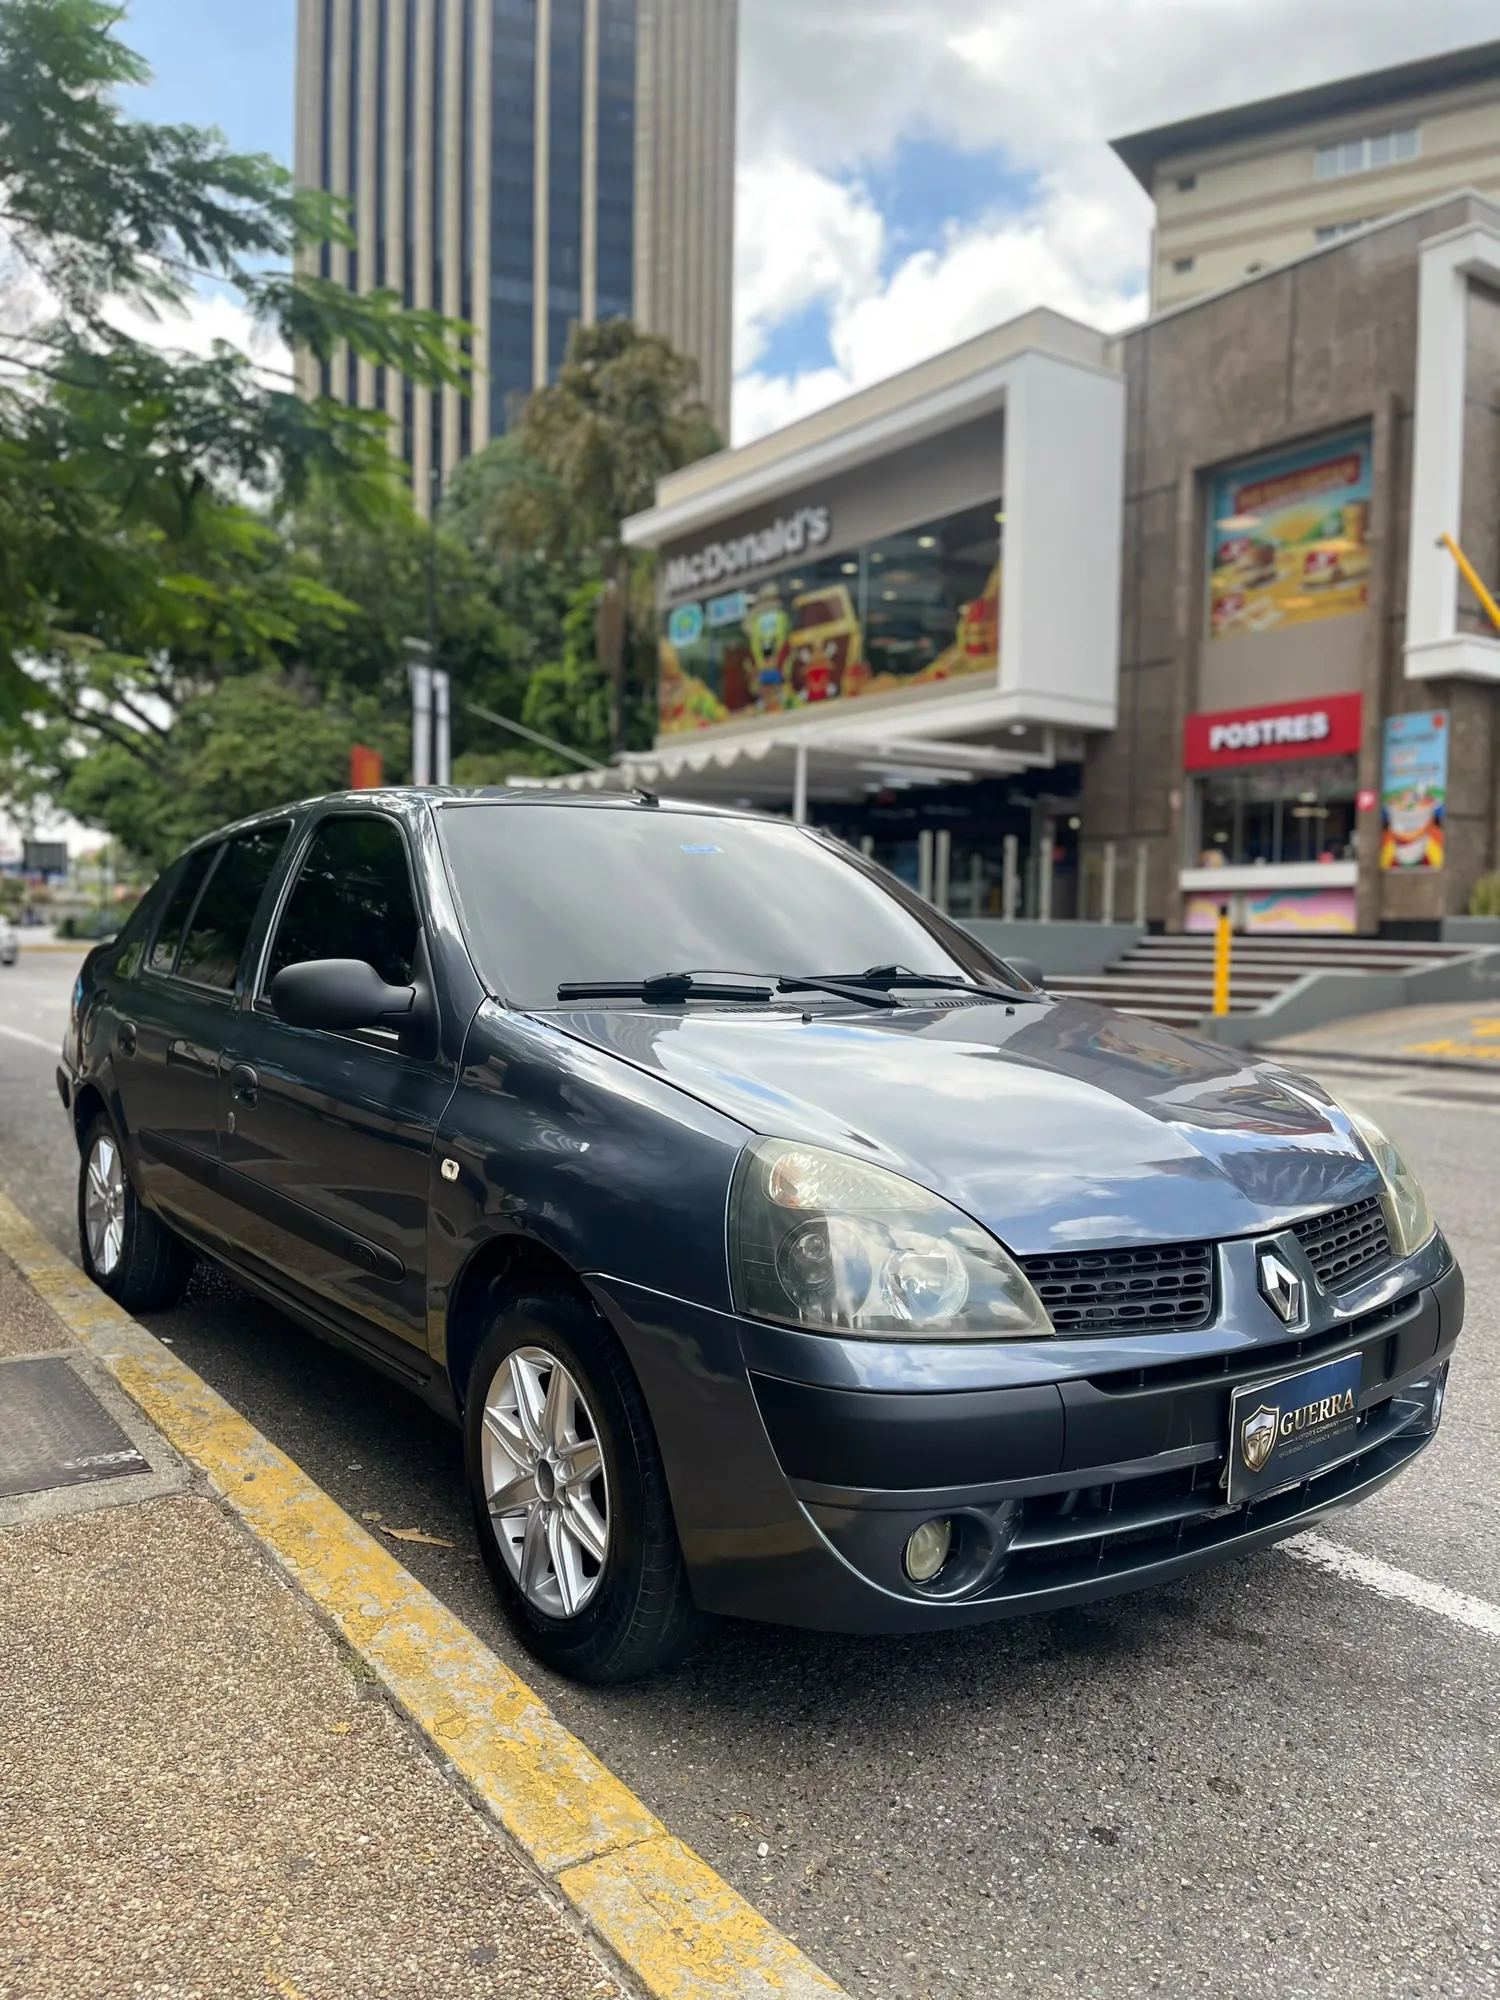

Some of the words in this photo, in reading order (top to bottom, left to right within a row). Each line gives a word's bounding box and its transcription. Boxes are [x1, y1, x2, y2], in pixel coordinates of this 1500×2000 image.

[667, 506, 828, 590] McDonald's
[1209, 712, 1328, 751] POSTRES
[1280, 1388, 1355, 1436] GUERRA
